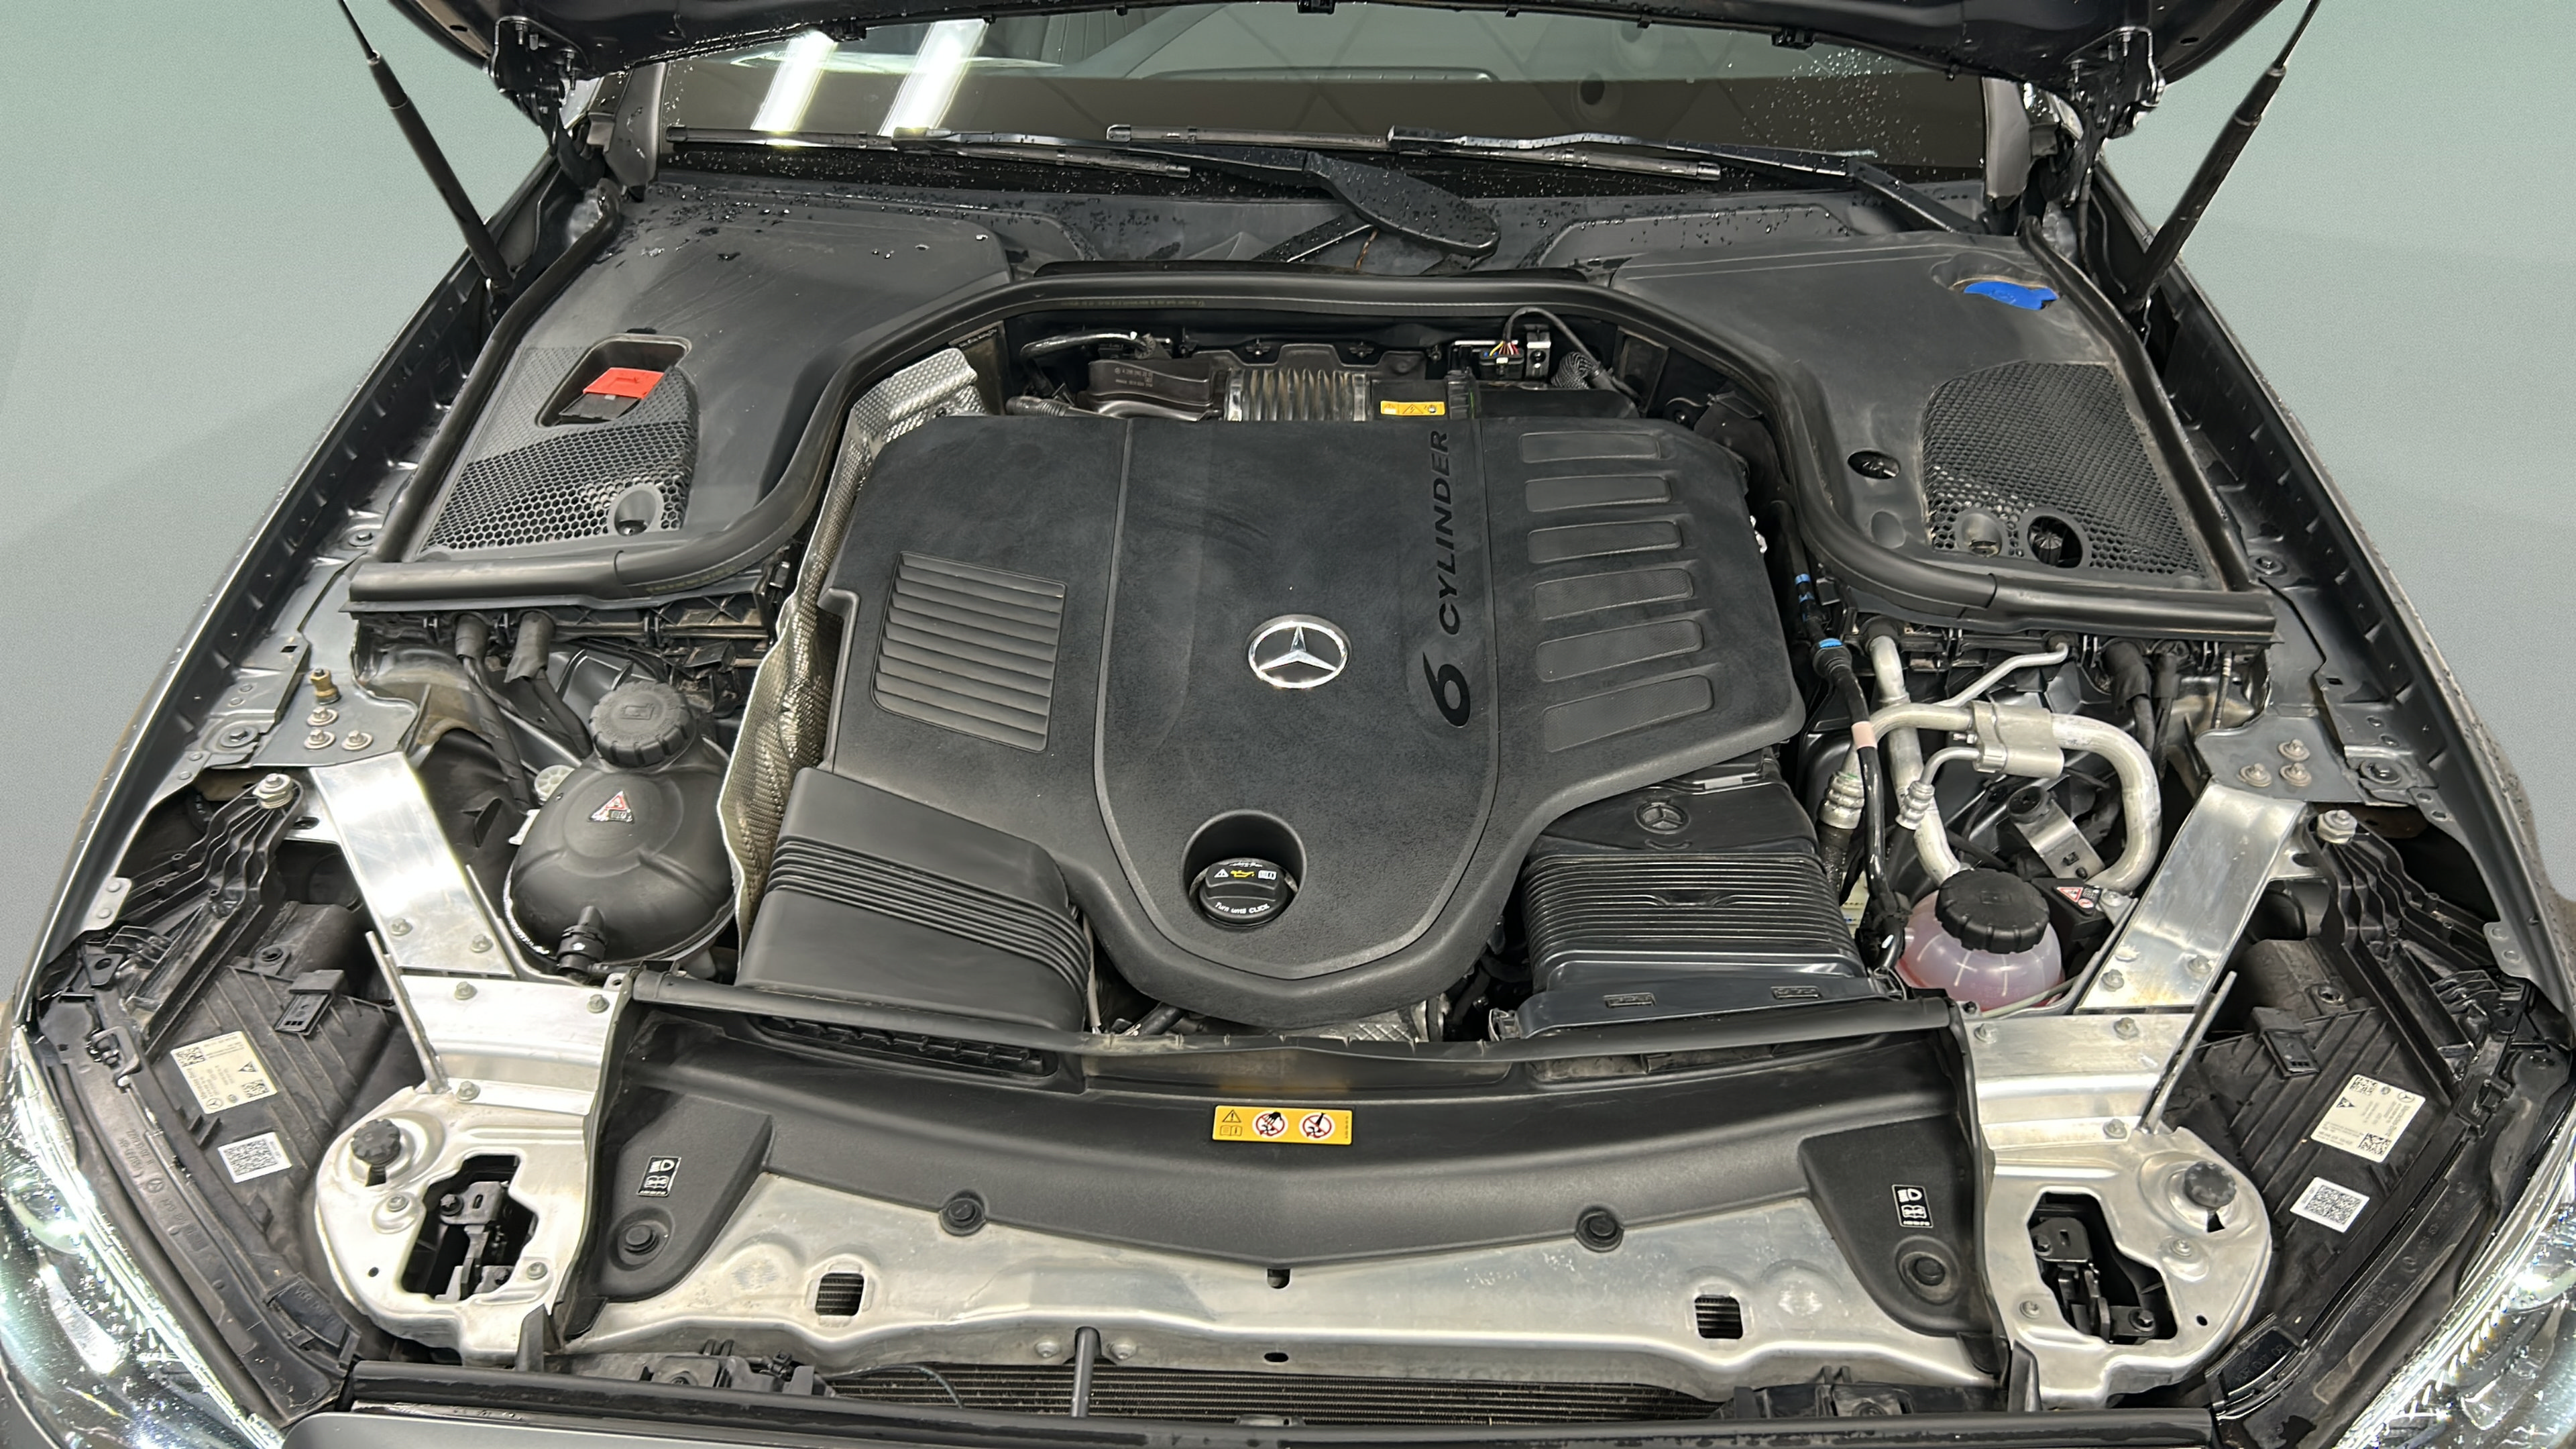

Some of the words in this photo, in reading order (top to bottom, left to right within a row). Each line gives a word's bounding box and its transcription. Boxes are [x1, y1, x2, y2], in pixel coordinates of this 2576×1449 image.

[1431, 430, 1461, 635] CYLINDER
[1215, 902, 1230, 912] Turn
[1249, 903, 1270, 914] CLICK
